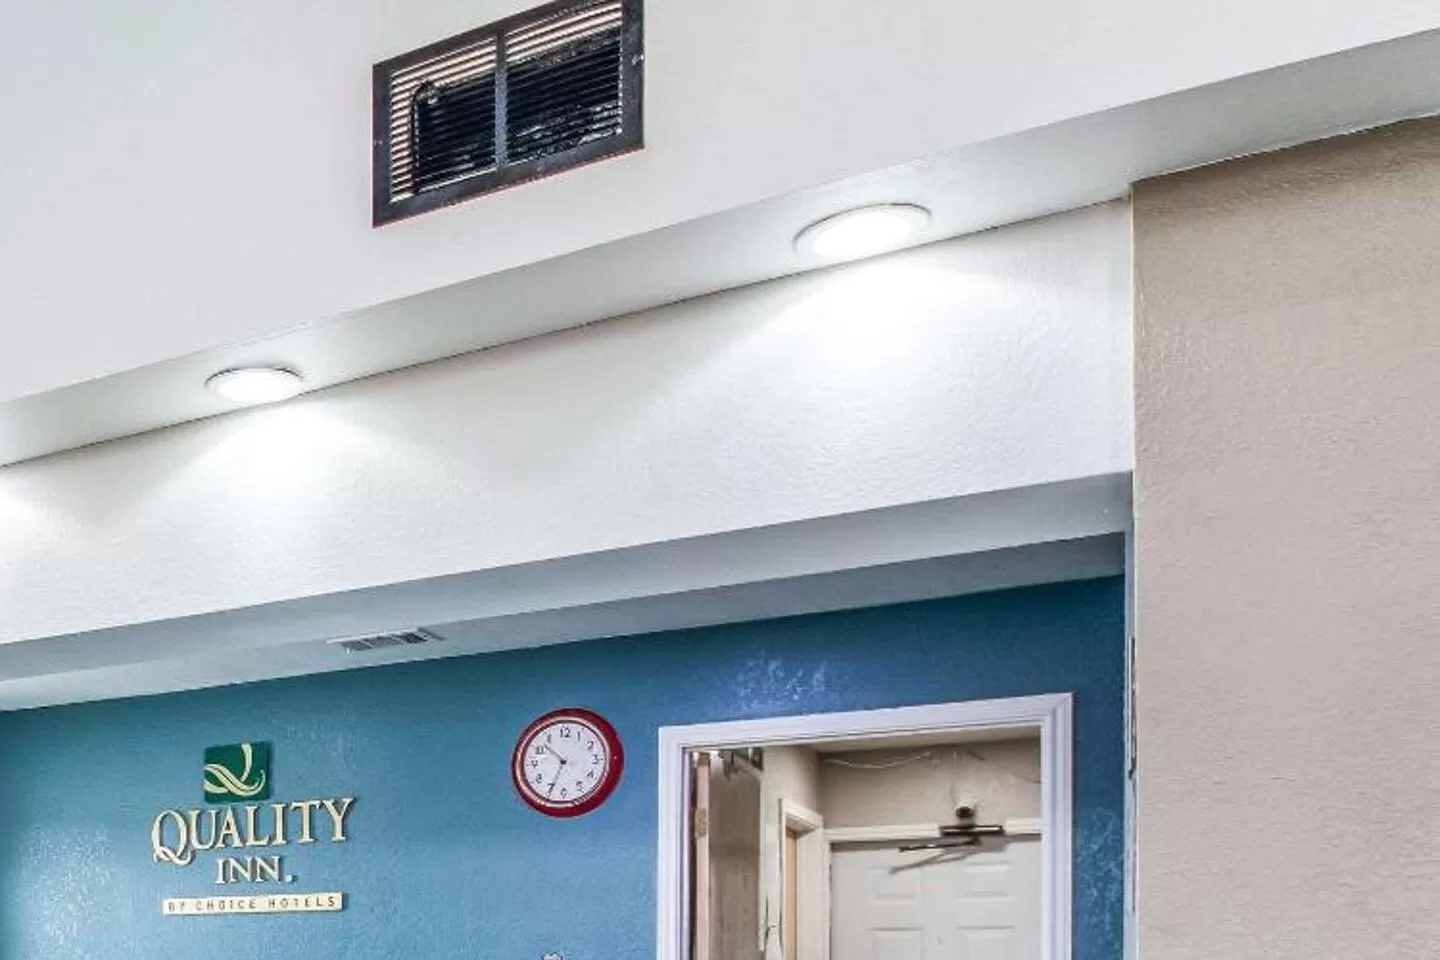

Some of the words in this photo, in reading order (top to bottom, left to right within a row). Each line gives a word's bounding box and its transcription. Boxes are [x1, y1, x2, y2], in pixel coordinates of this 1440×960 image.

[560, 727, 571, 738] 12
[592, 754, 599, 765] 3
[150, 798, 356, 866] QUALITY
[168, 900, 185, 912] BY
[195, 898, 256, 911] CHOICE
[268, 895, 336, 909] HOTELS
